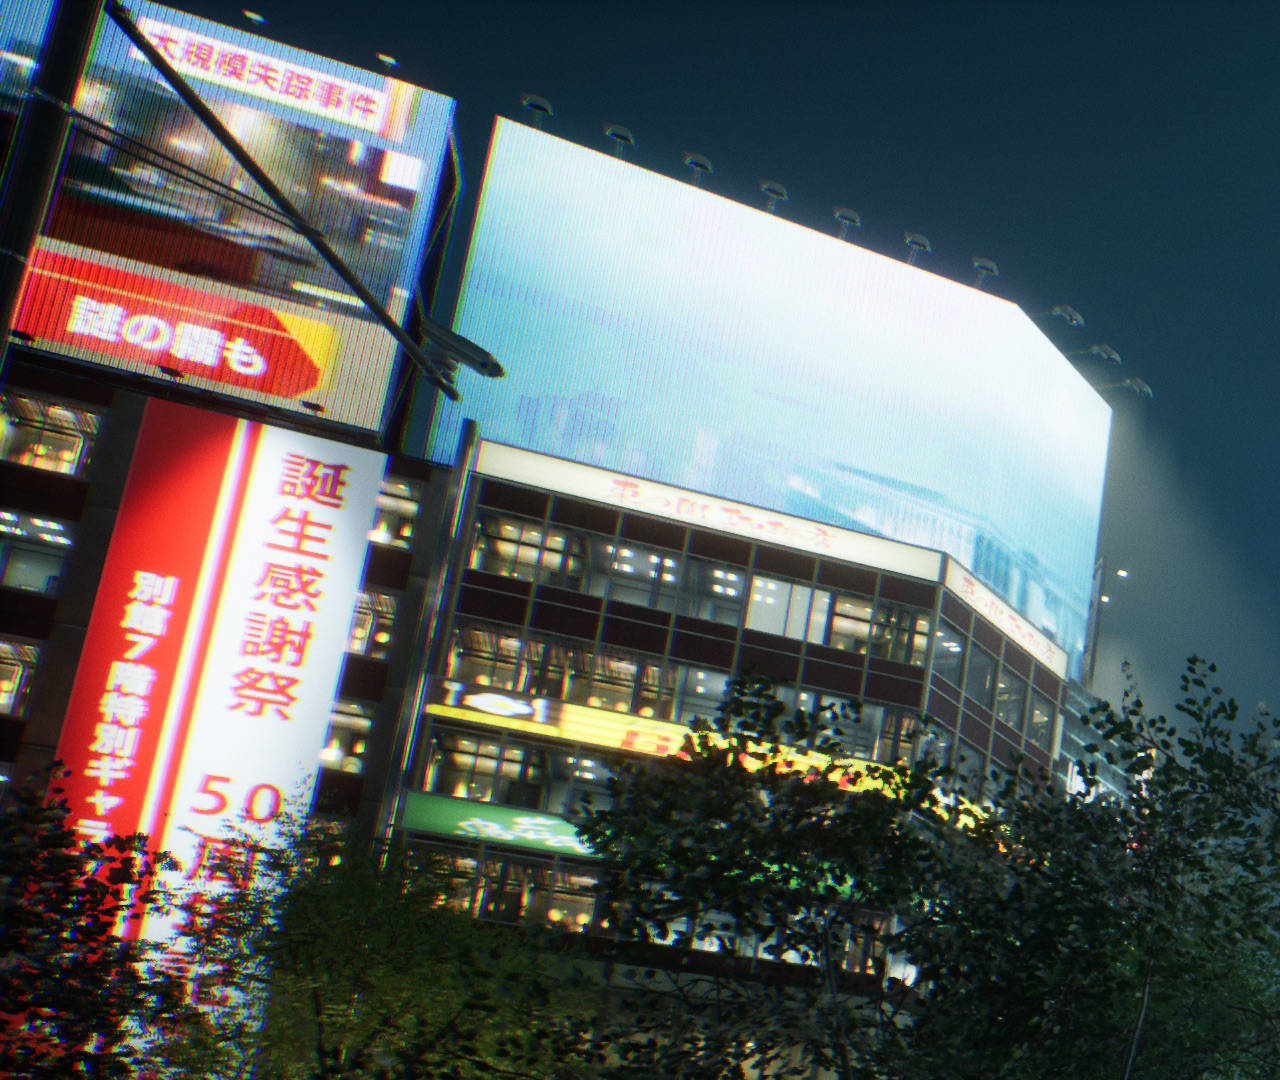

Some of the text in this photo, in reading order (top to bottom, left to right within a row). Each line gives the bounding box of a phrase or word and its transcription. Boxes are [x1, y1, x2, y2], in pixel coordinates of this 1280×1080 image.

[150, 31, 382, 119] 大規模失踪事件
[226, 451, 354, 723] 誕生感謝祭
[188, 774, 283, 824] 50
